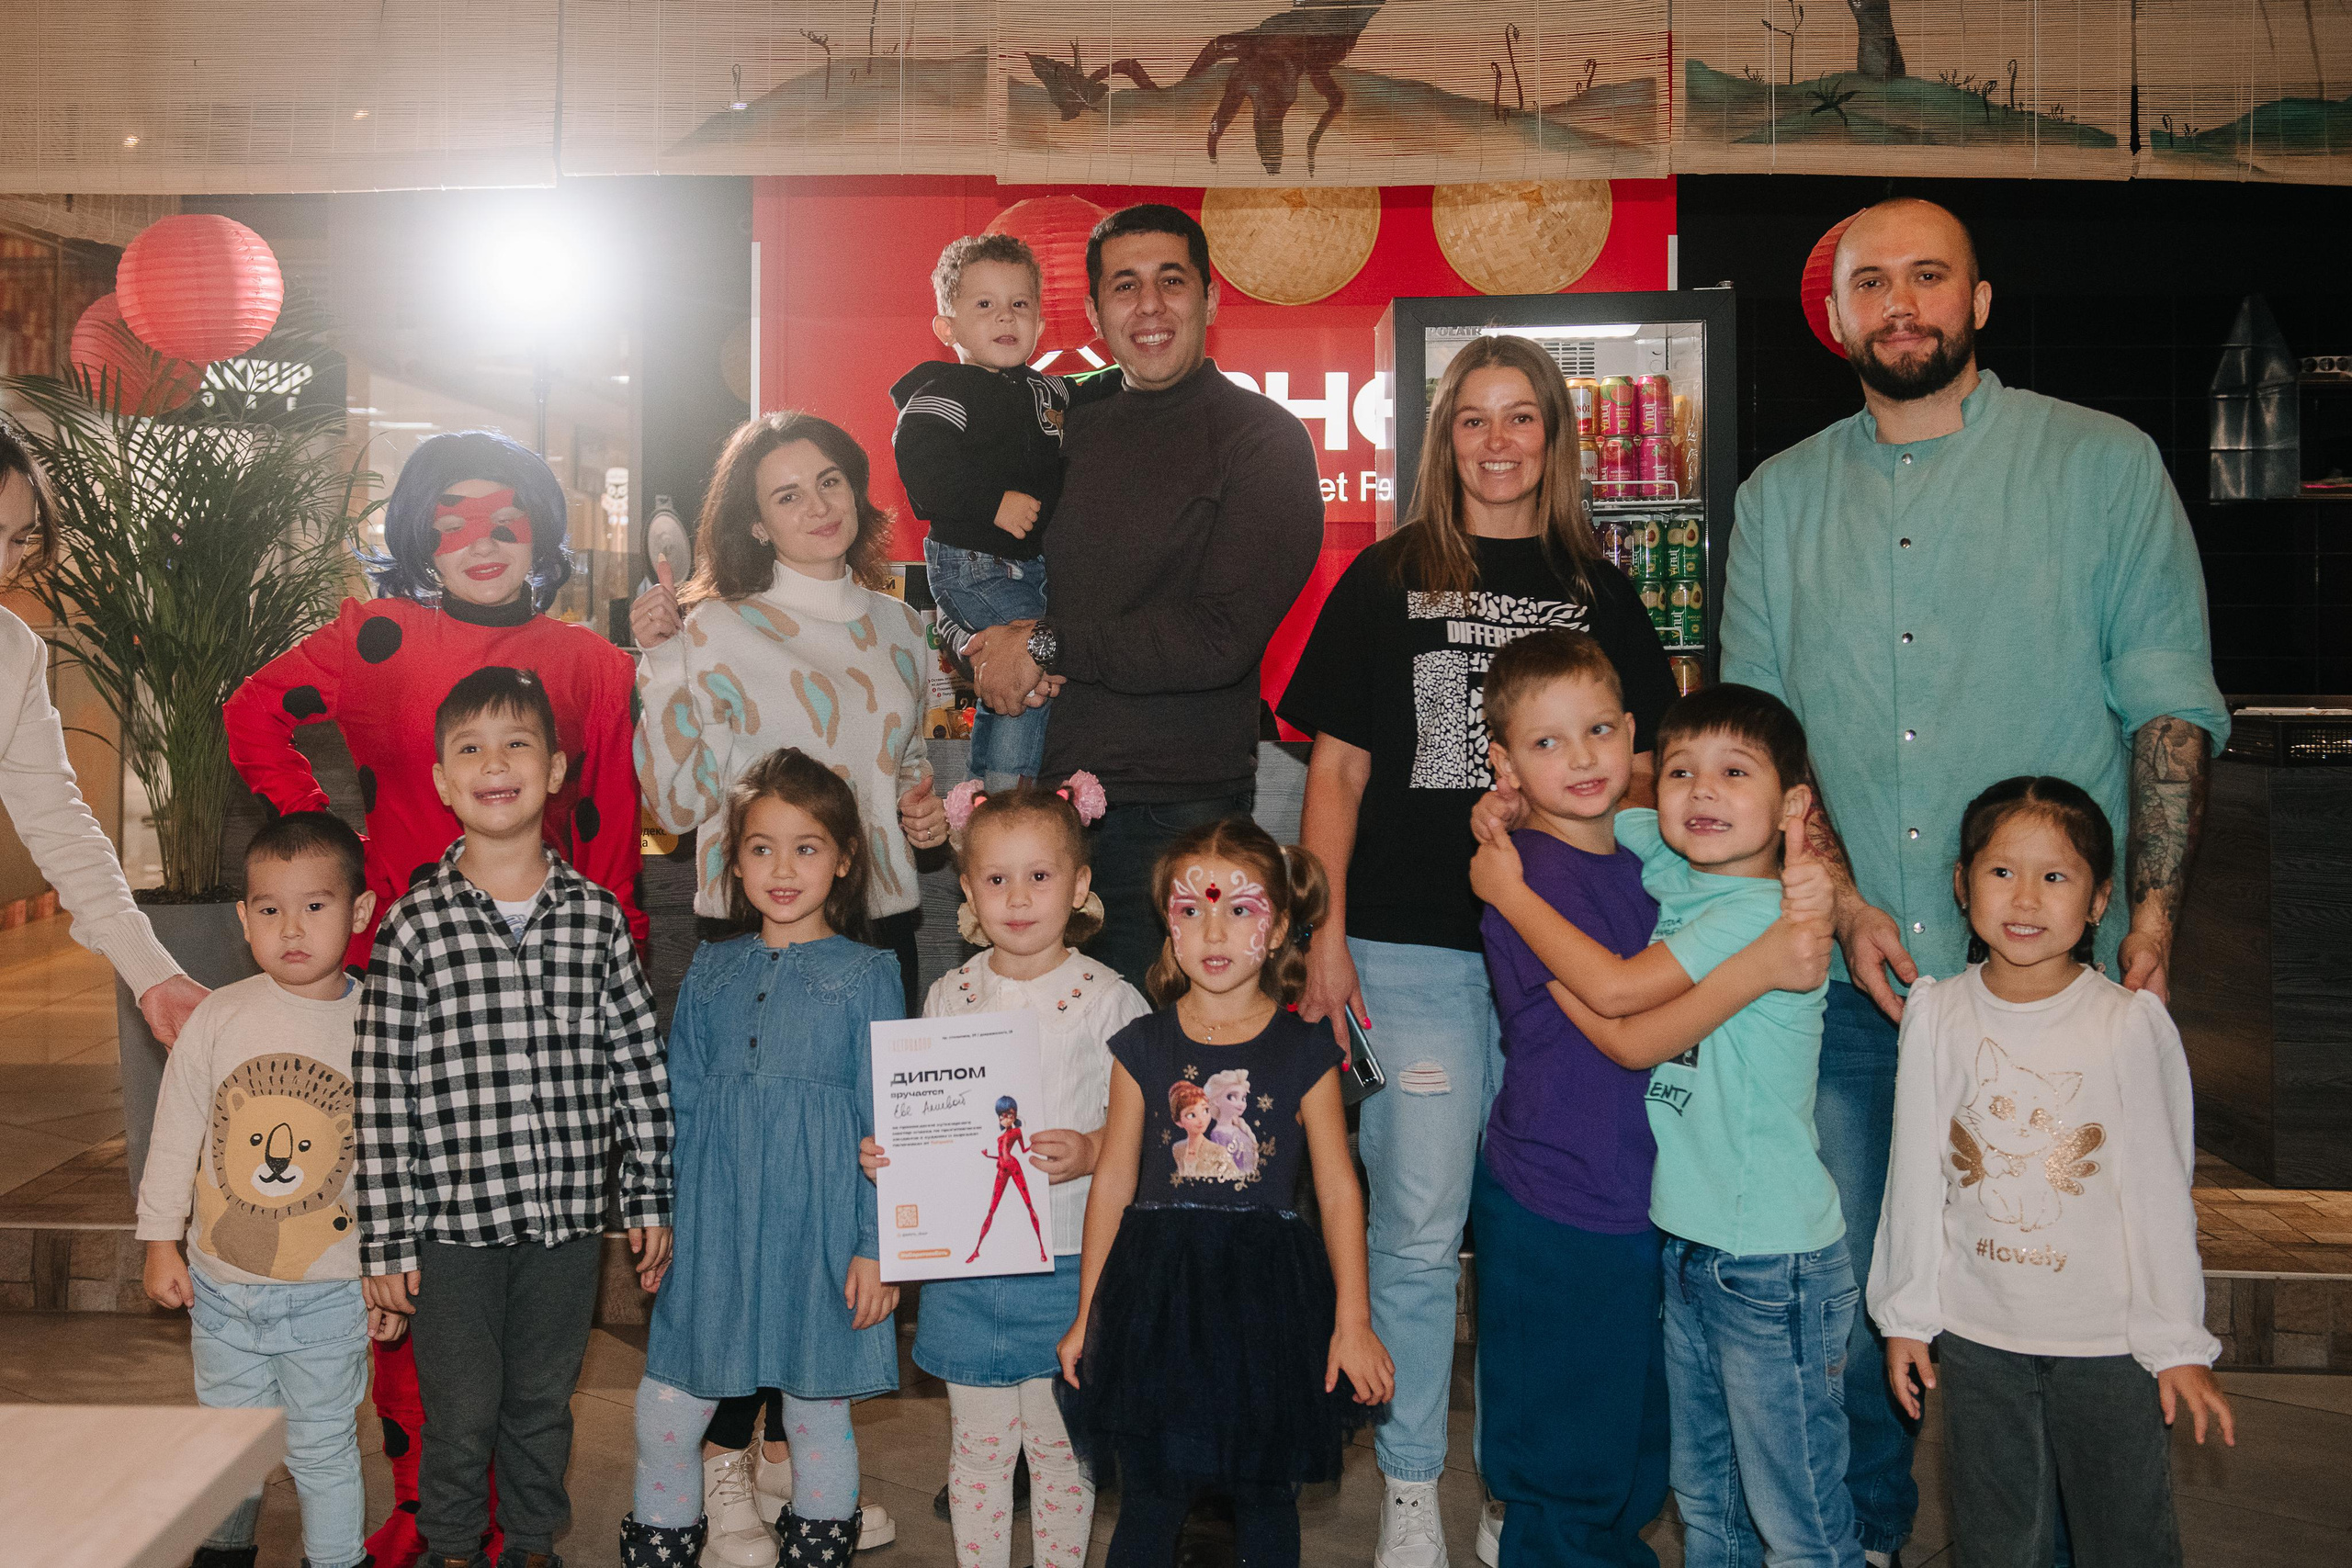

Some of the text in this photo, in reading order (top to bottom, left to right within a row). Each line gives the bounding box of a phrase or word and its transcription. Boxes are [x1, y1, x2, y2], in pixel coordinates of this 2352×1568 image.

[1427, 325, 1482, 337] POLAIR
[200, 358, 313, 395] AKEUP
[1642, 400, 1657, 431] Vinut
[890, 1066, 986, 1087] ДИПЛОМ
[890, 1089, 944, 1100] вручается
[1976, 1237, 2067, 1272] #lovely
